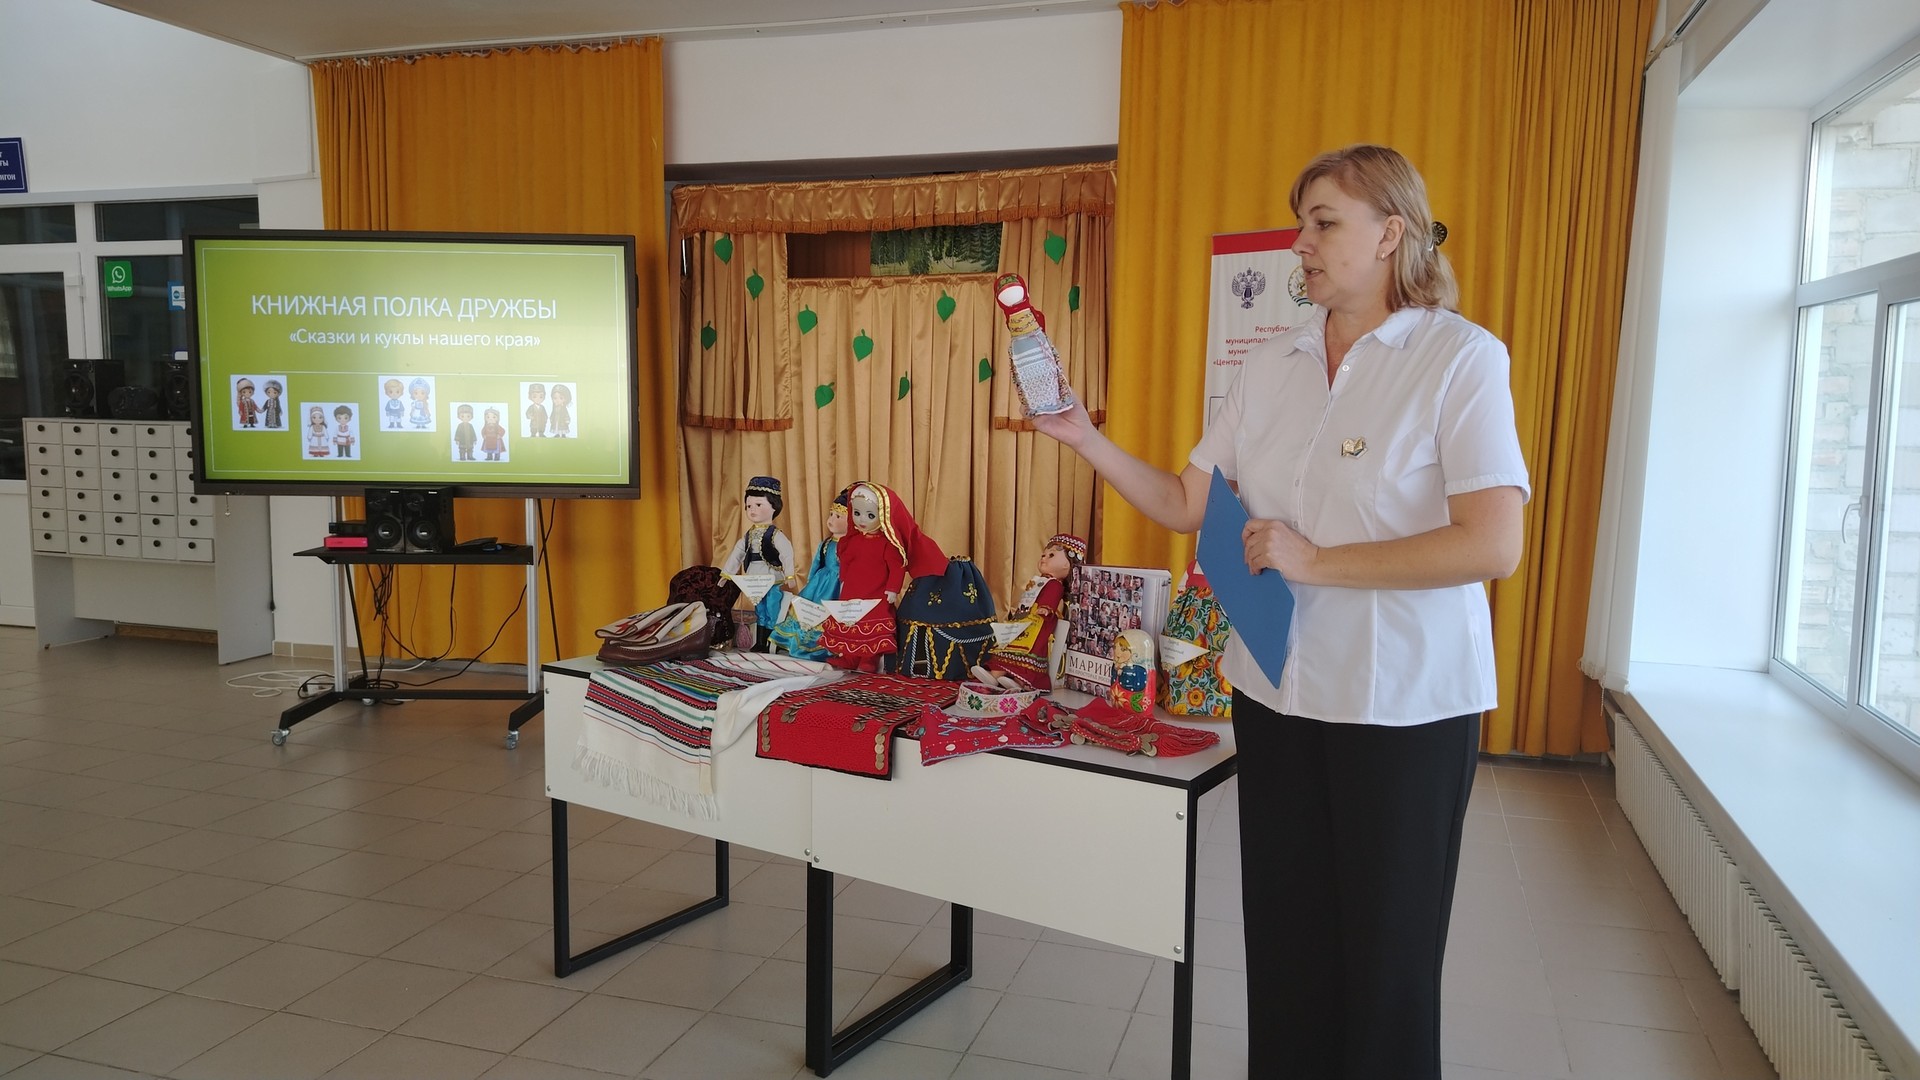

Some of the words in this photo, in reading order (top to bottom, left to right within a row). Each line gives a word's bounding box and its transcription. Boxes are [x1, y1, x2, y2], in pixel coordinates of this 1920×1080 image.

[251, 294, 366, 316] КНИЖНАЯ
[373, 296, 452, 317] ПОЛКА
[457, 297, 557, 322] ДРУЖБЫ
[1254, 325, 1292, 334] Республи
[289, 328, 356, 344] «Сказки
[360, 332, 370, 345] и
[375, 333, 424, 349] куклы
[428, 333, 491, 346] нашего
[495, 334, 541, 350] края»
[1225, 337, 1269, 346] муниципал
[1228, 348, 1248, 356] муни
[1069, 655, 1112, 678] МАРИЙ
